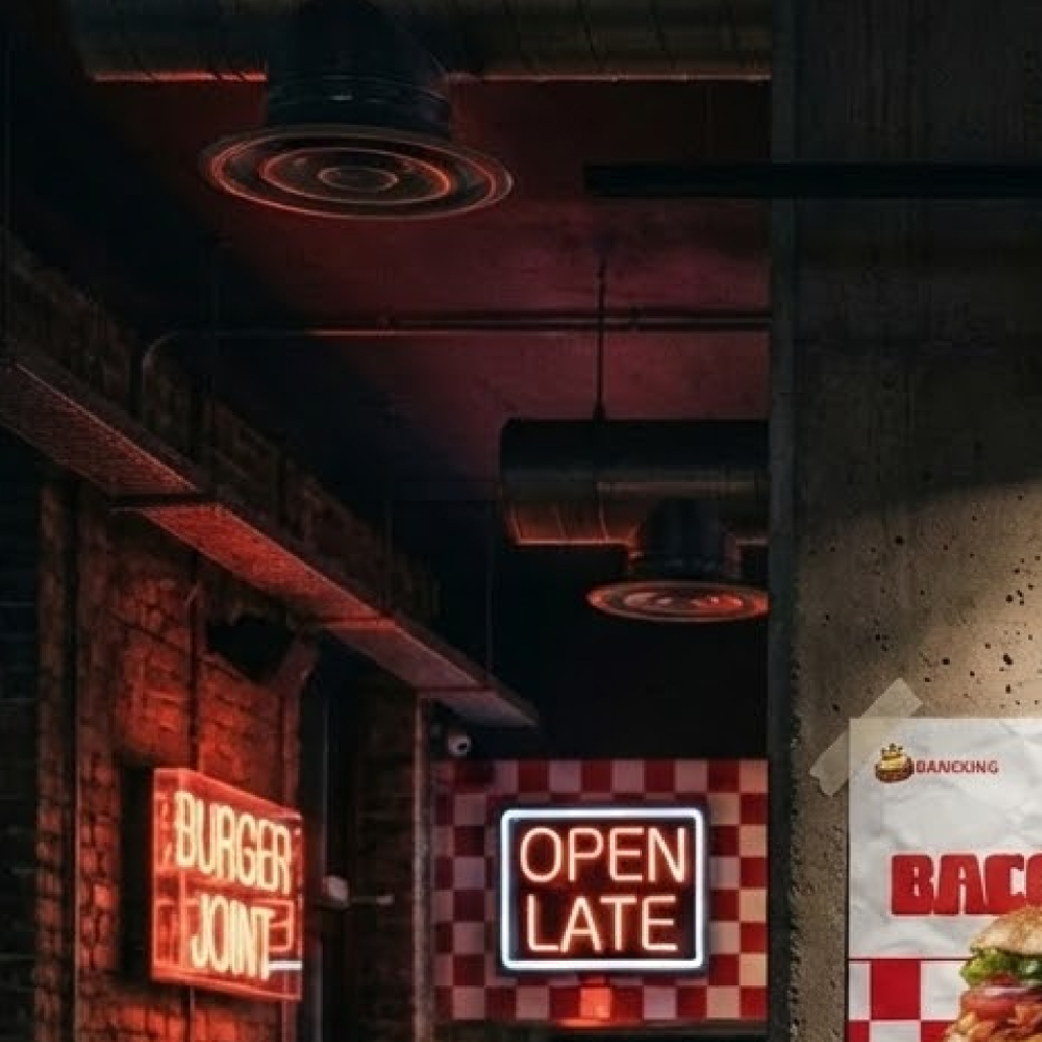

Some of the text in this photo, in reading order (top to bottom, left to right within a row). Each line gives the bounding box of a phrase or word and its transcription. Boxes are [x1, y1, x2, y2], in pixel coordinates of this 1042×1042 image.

[174, 791, 292, 895] BURGER
[519, 826, 687, 884] OPEN
[192, 894, 275, 980] JOINT
[525, 895, 678, 953] LATE
